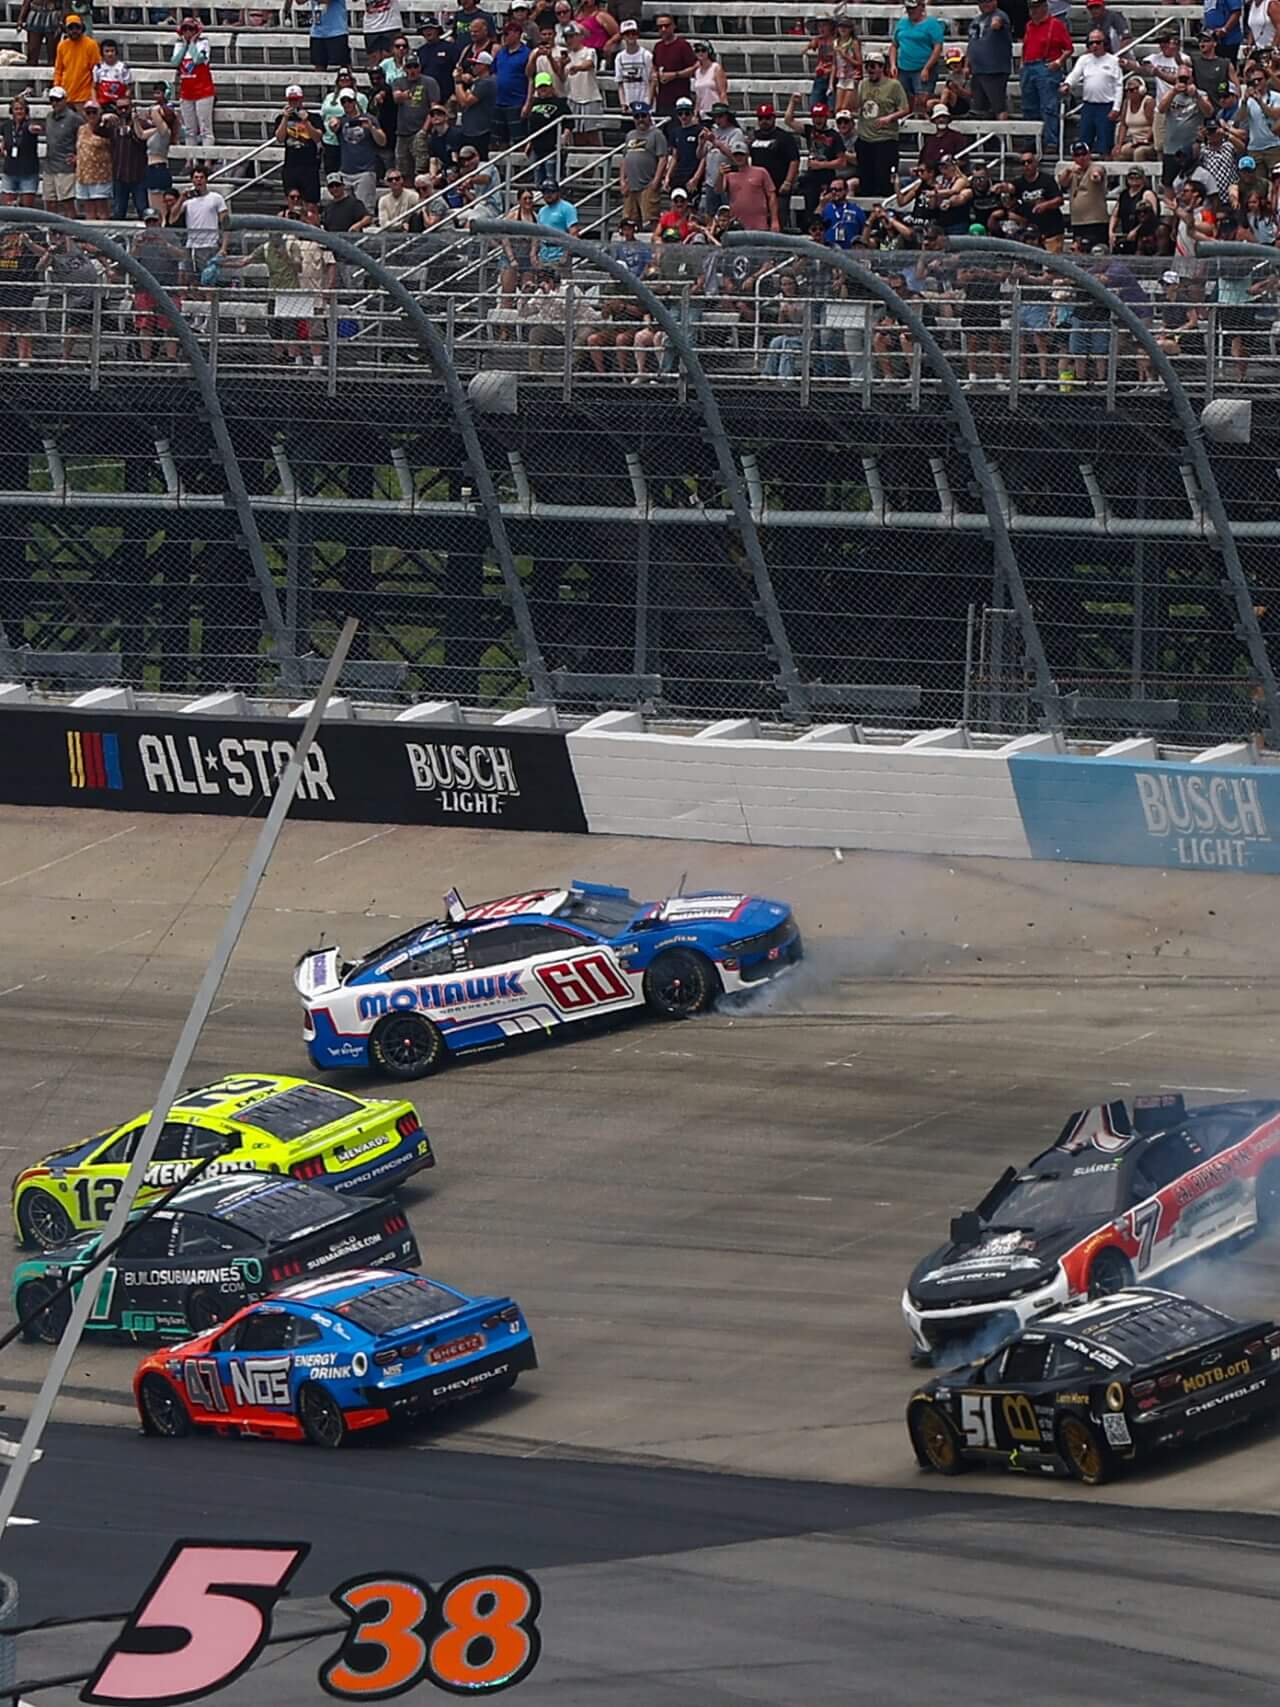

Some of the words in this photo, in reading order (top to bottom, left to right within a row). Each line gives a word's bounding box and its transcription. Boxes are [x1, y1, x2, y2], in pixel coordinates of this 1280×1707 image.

[405, 743, 520, 796] BUSCH
[441, 791, 502, 814] LIGHT
[1135, 773, 1272, 842] BUSCH
[1177, 838, 1247, 867] LIGHT
[356, 969, 529, 1022] MOHAWK
[535, 955, 632, 1010] 60
[73, 1177, 125, 1223] 12
[1133, 1199, 1162, 1273] 7
[294, 1352, 338, 1368] ENERGY
[309, 1366, 352, 1380] DRINK
[431, 1339, 480, 1361] SHEETZ
[184, 1358, 230, 1414] 47
[229, 1355, 292, 1406] NOS
[432, 1364, 511, 1396] CHEVROLET
[1182, 1359, 1251, 1394] MOTB.org
[1185, 1378, 1268, 1416] CHEVROLET
[960, 1394, 998, 1449] 51
[81, 1538, 310, 1706] 5
[319, 1566, 542, 1701] 38
